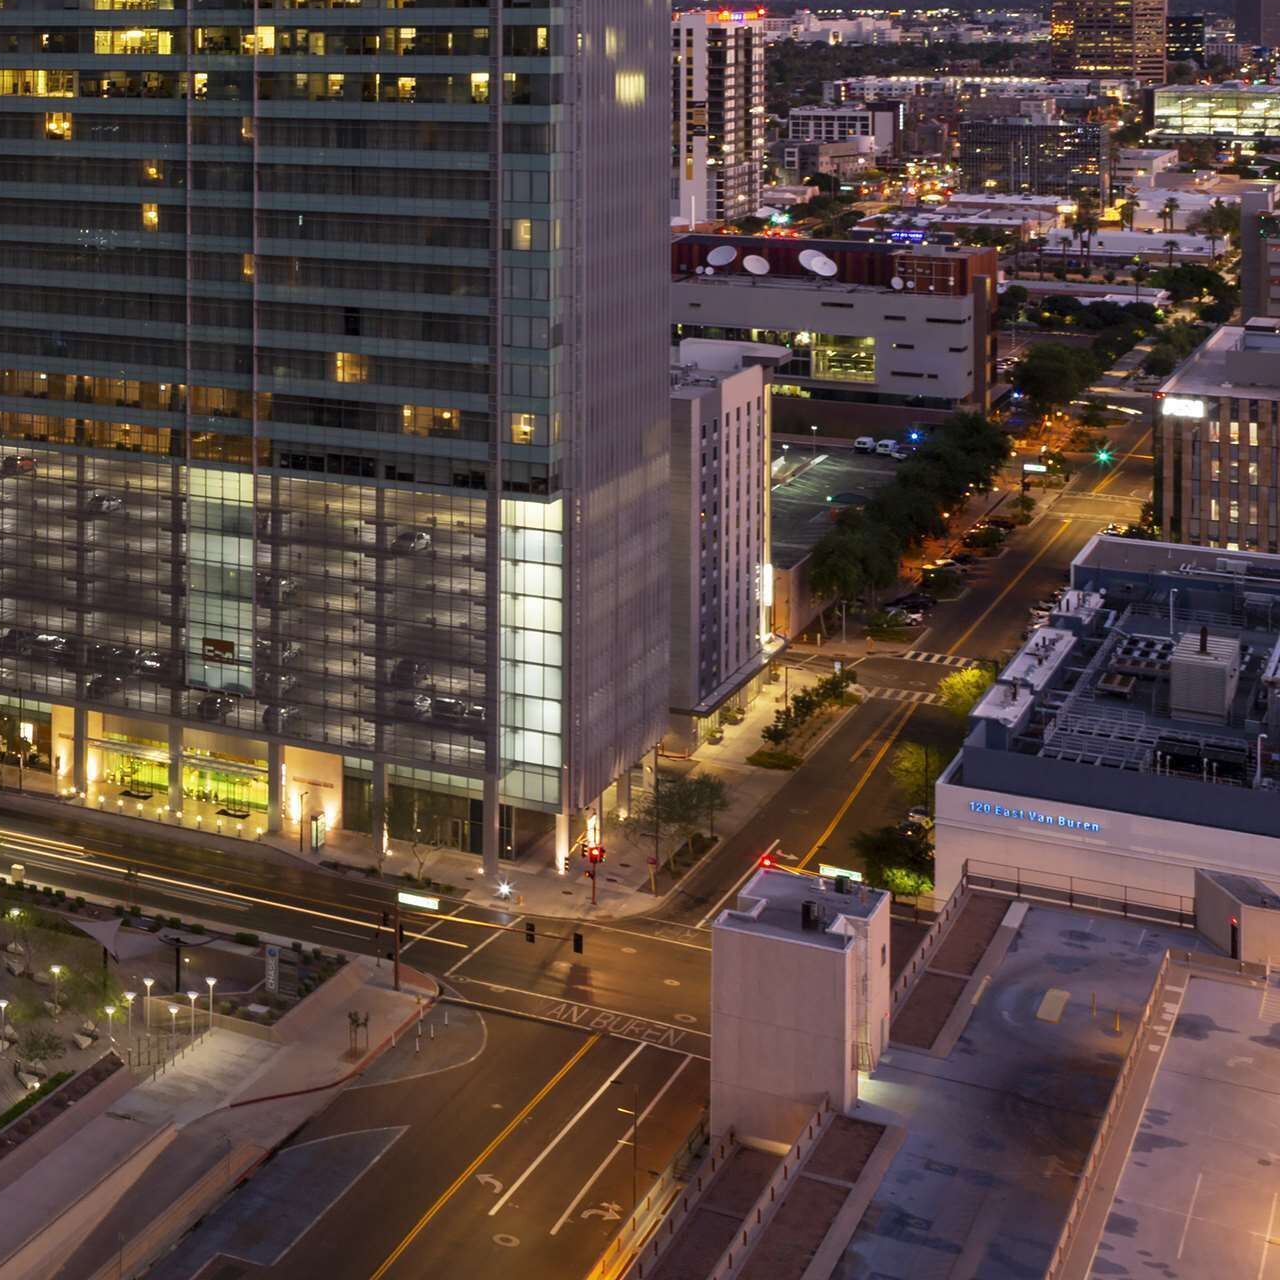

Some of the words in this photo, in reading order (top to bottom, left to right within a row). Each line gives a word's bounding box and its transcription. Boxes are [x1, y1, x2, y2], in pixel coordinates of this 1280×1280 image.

[969, 801, 991, 814] 120
[995, 806, 1024, 819] East
[1028, 811, 1053, 824] Van
[1058, 816, 1099, 832] Buren
[589, 1012, 687, 1046] BUREN
